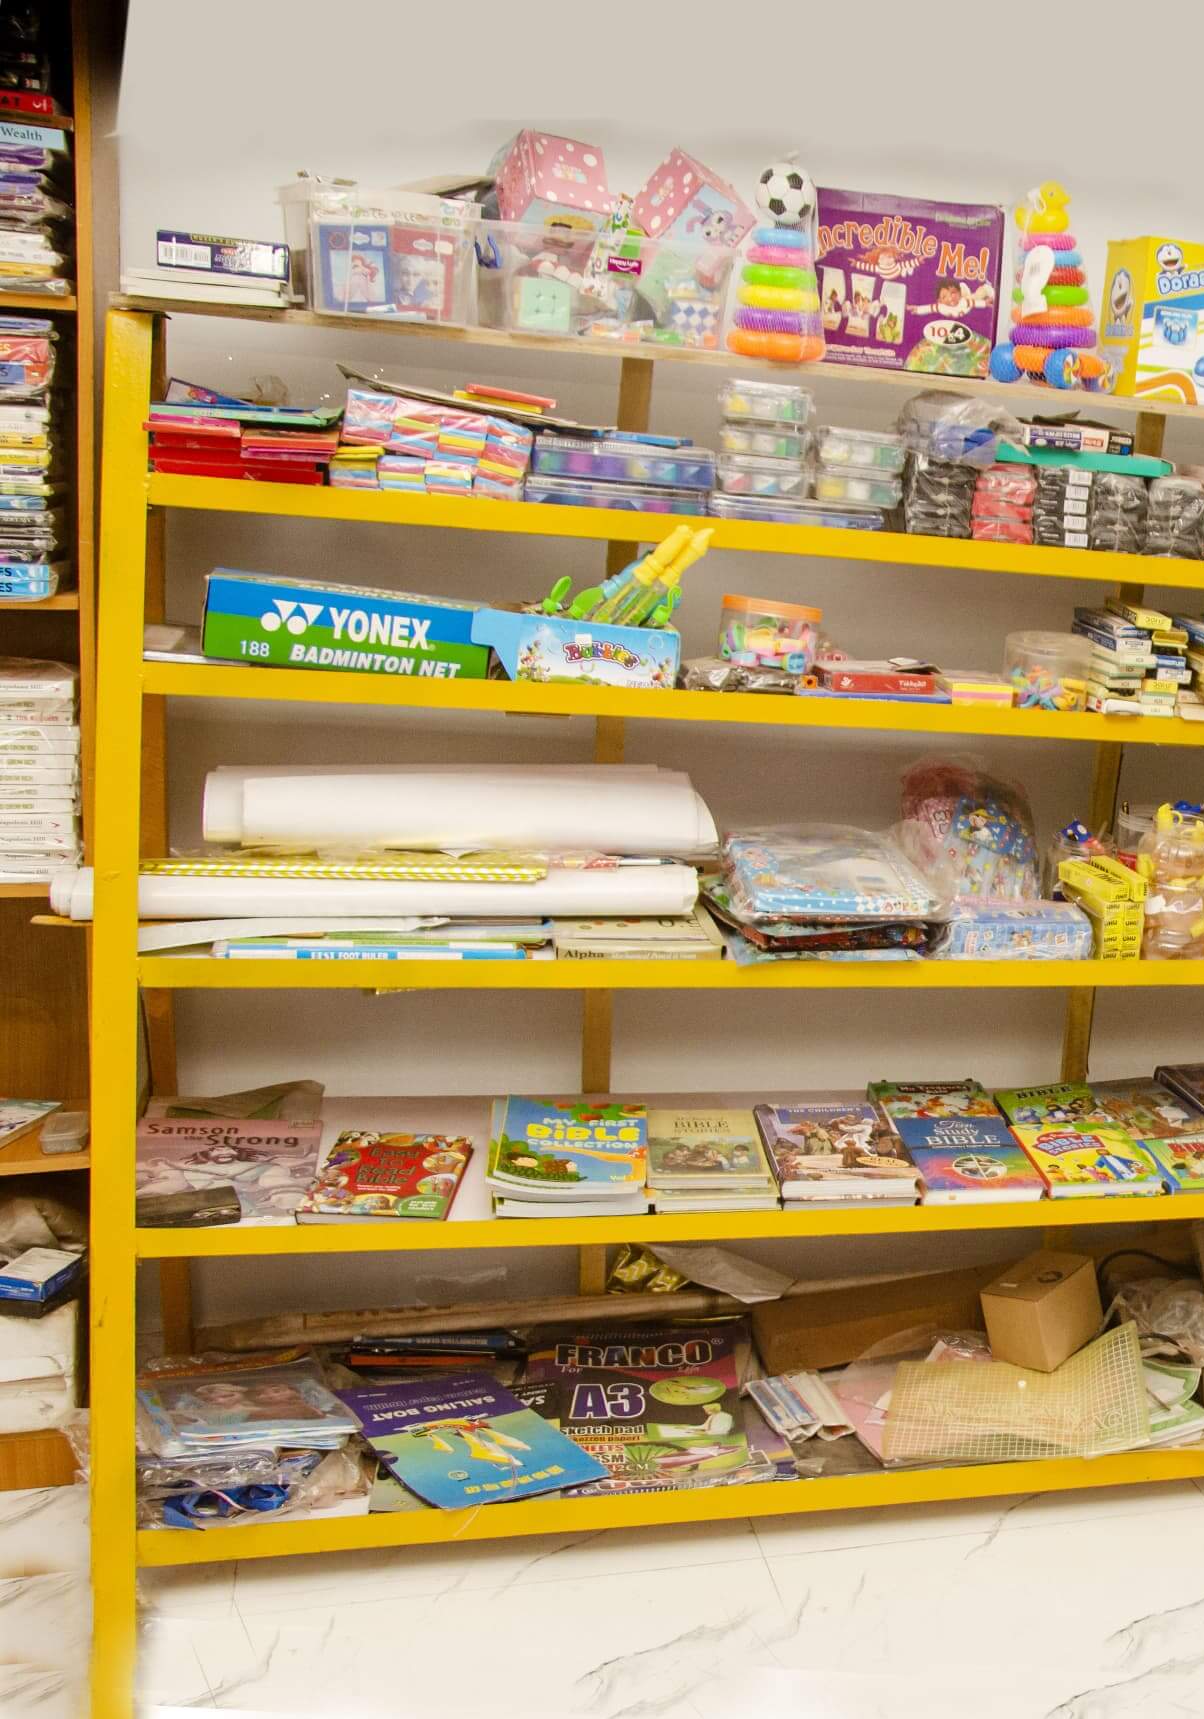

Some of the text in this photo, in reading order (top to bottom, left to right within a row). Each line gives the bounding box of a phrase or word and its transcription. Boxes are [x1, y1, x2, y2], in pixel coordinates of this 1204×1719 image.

[0, 126, 42, 141] Wealth
[817, 215, 990, 281] ncredible Me!
[329, 607, 432, 650] YONEX
[240, 640, 461, 679] 188 BADMINTON NET
[338, 952, 361, 960] FOOT
[362, 952, 389, 960] RULER
[564, 949, 605, 959] Alpha
[543, 1117, 576, 1126] MY
[674, 1120, 729, 1129] BIBLE
[147, 1123, 239, 1136] Samson
[933, 1128, 979, 1137] Study
[206, 1134, 300, 1148] Strong
[925, 1134, 1001, 1145] BIBLE
[555, 1339, 712, 1368] FRANCO
[569, 1383, 646, 1420] A3
[371, 1395, 496, 1422] SAILING BOAT
[613, 1424, 644, 1436] pad
